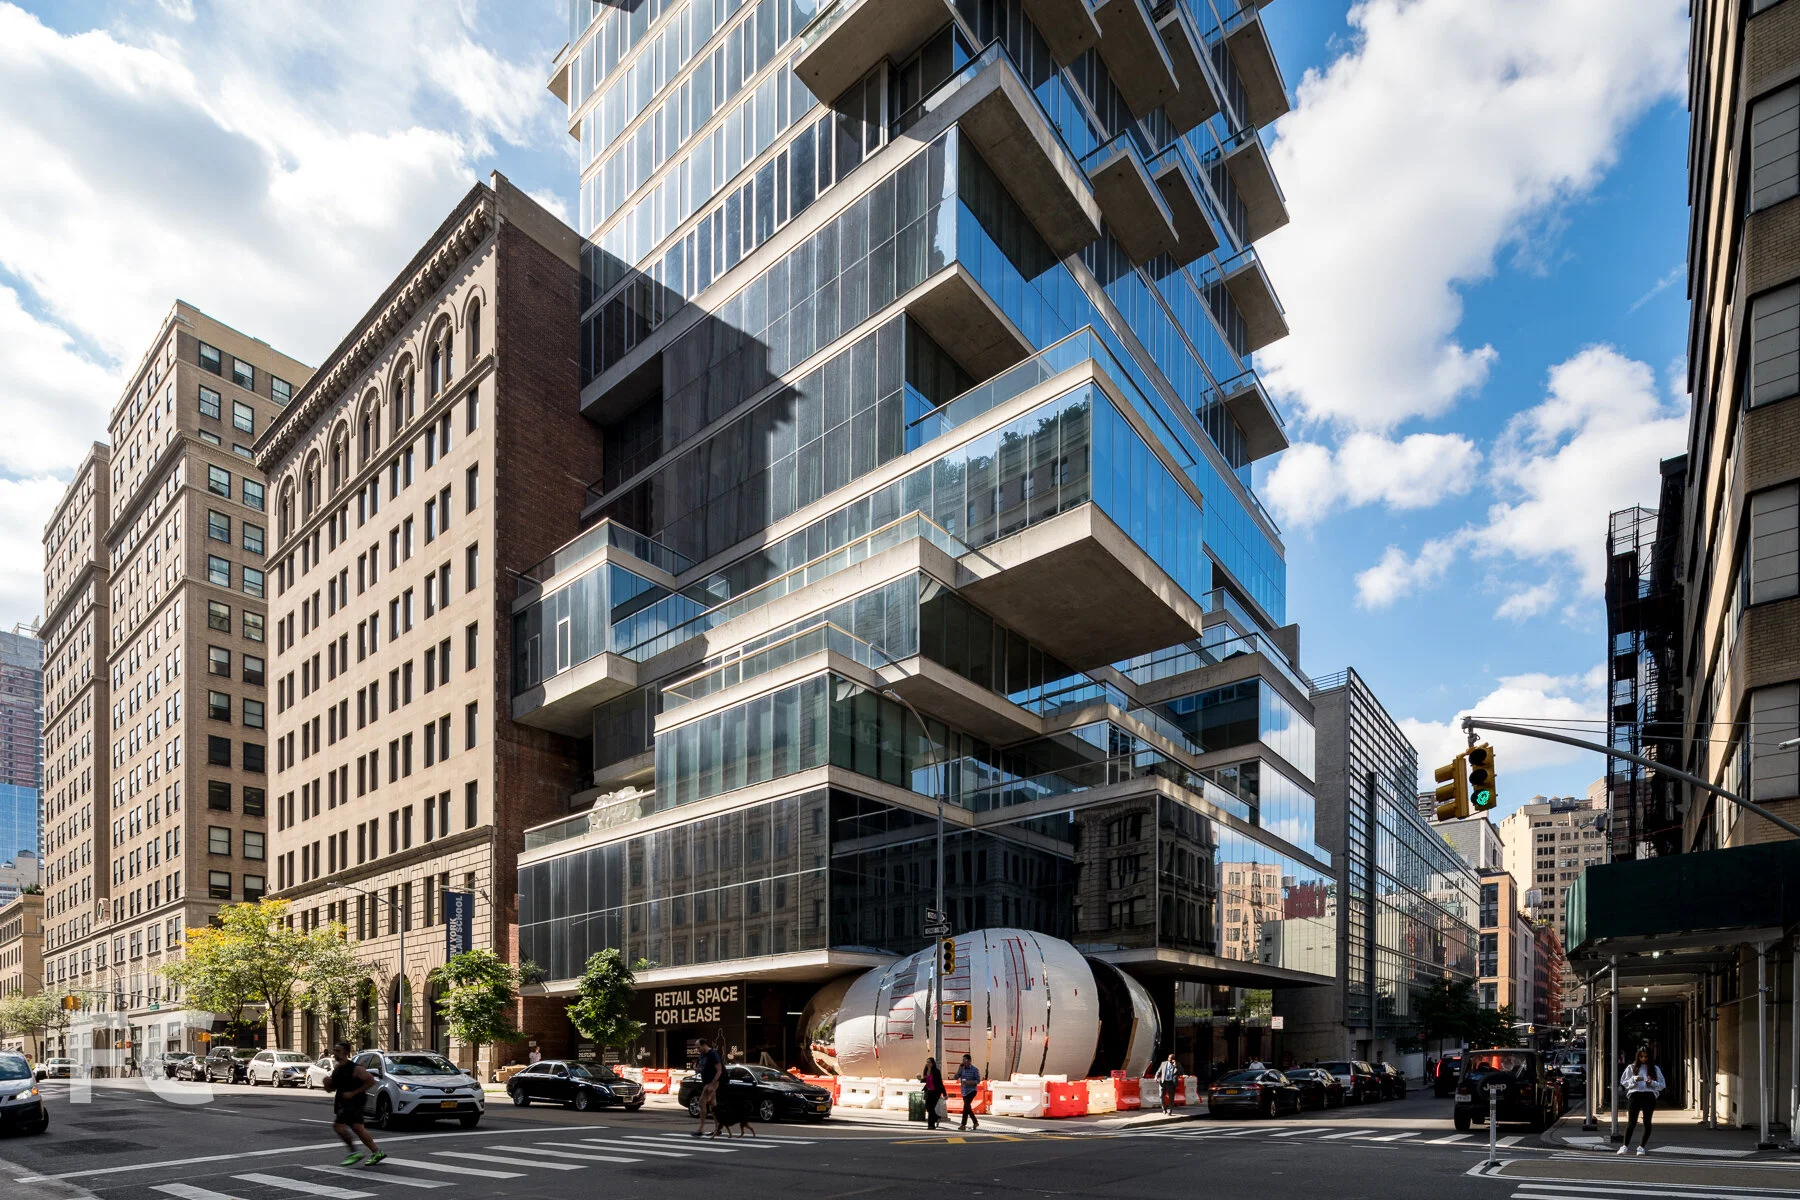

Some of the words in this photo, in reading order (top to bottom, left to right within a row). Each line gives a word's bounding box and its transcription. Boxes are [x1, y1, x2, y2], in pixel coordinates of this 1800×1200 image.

[655, 990, 694, 1007] RETAIL
[696, 986, 738, 1004] SPACE
[655, 1010, 678, 1024] FOR
[682, 1006, 720, 1024] LEASE
[1482, 1083, 1507, 1092] Jeep
